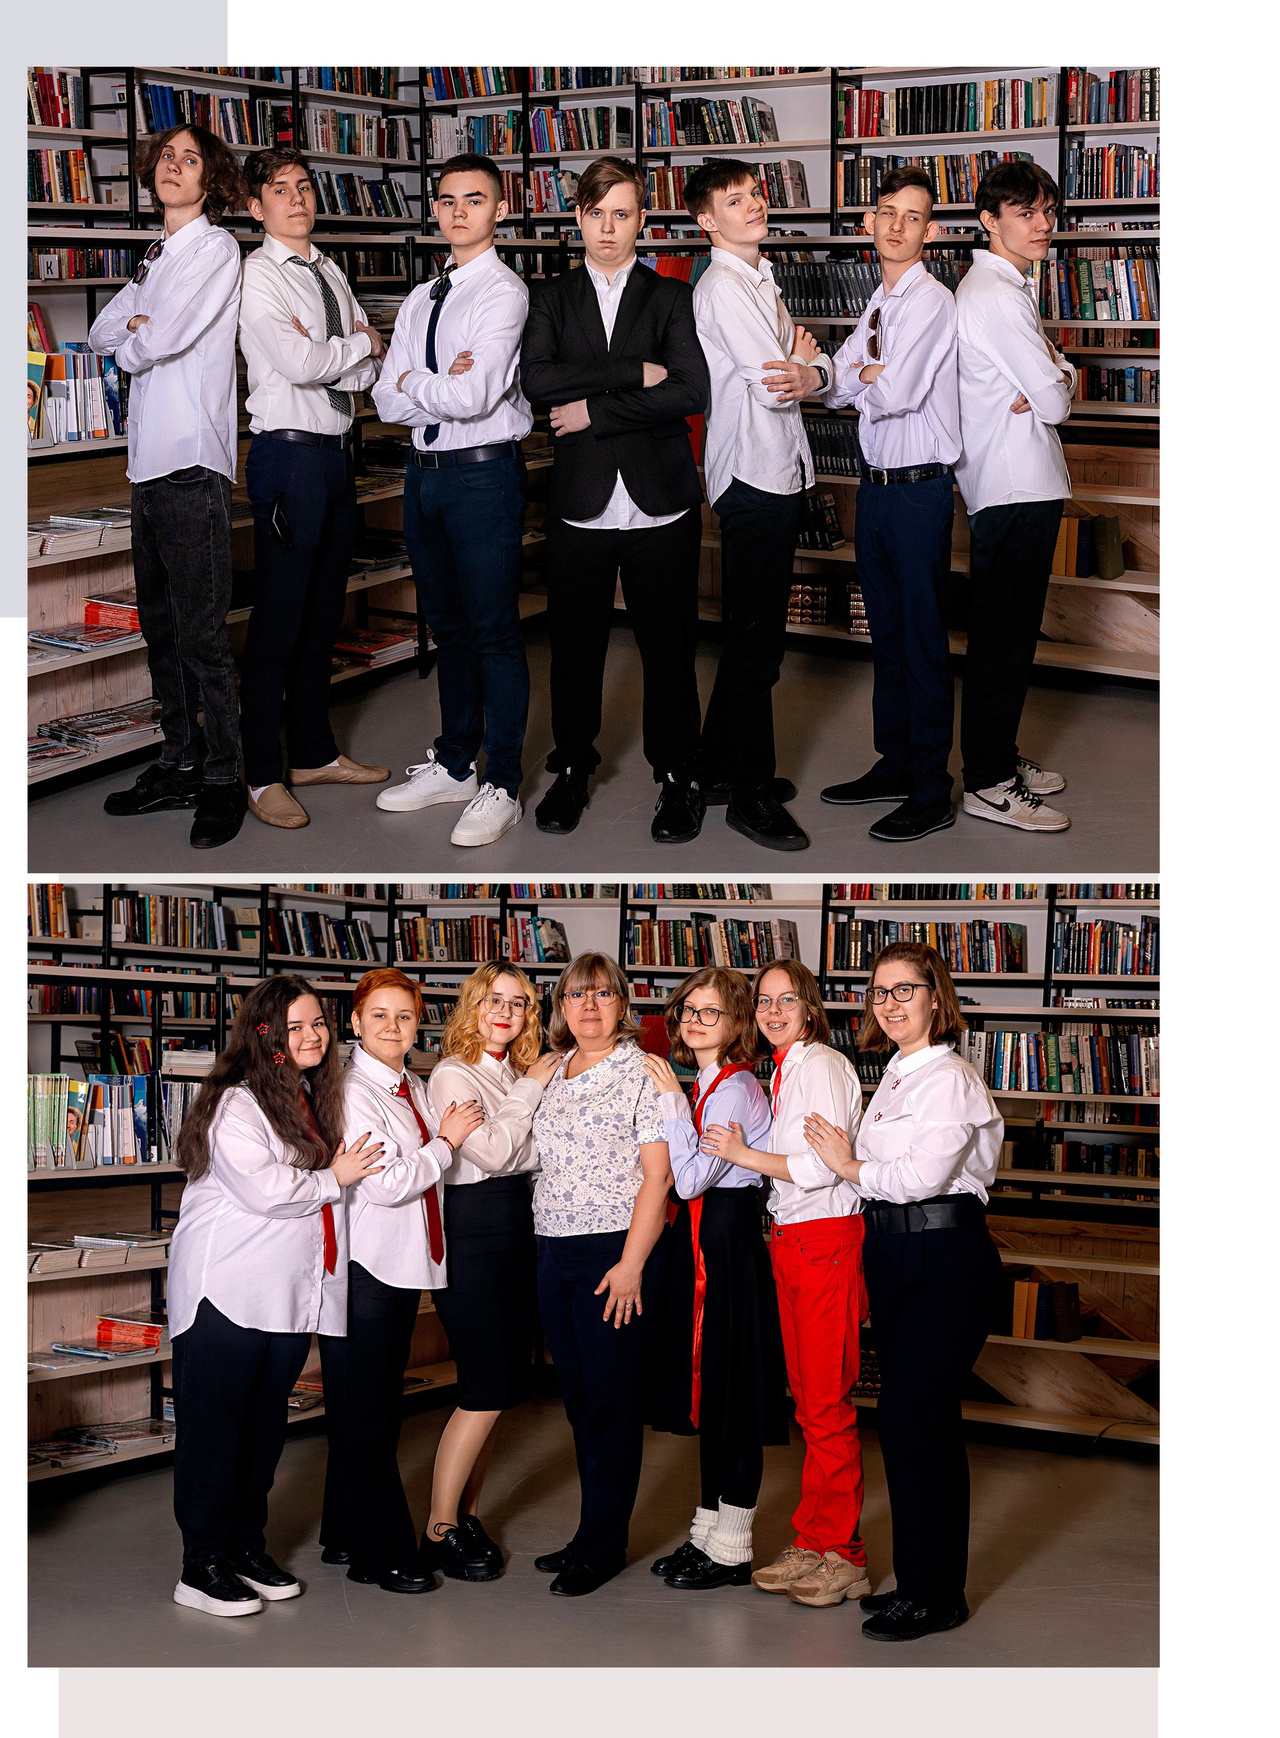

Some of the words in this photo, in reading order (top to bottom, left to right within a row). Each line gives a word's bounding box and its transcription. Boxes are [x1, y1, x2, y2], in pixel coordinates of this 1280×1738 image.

[528, 194, 534, 205] Р
[46, 261, 54, 275] К
[1080, 262, 1091, 304] МЕТРОПОЛЬ
[439, 948, 445, 957] О
[505, 942, 510, 953] Р
[430, 1008, 437, 1020] П
[1048, 1036, 1058, 1077] МЕТРОПОЛЬ
